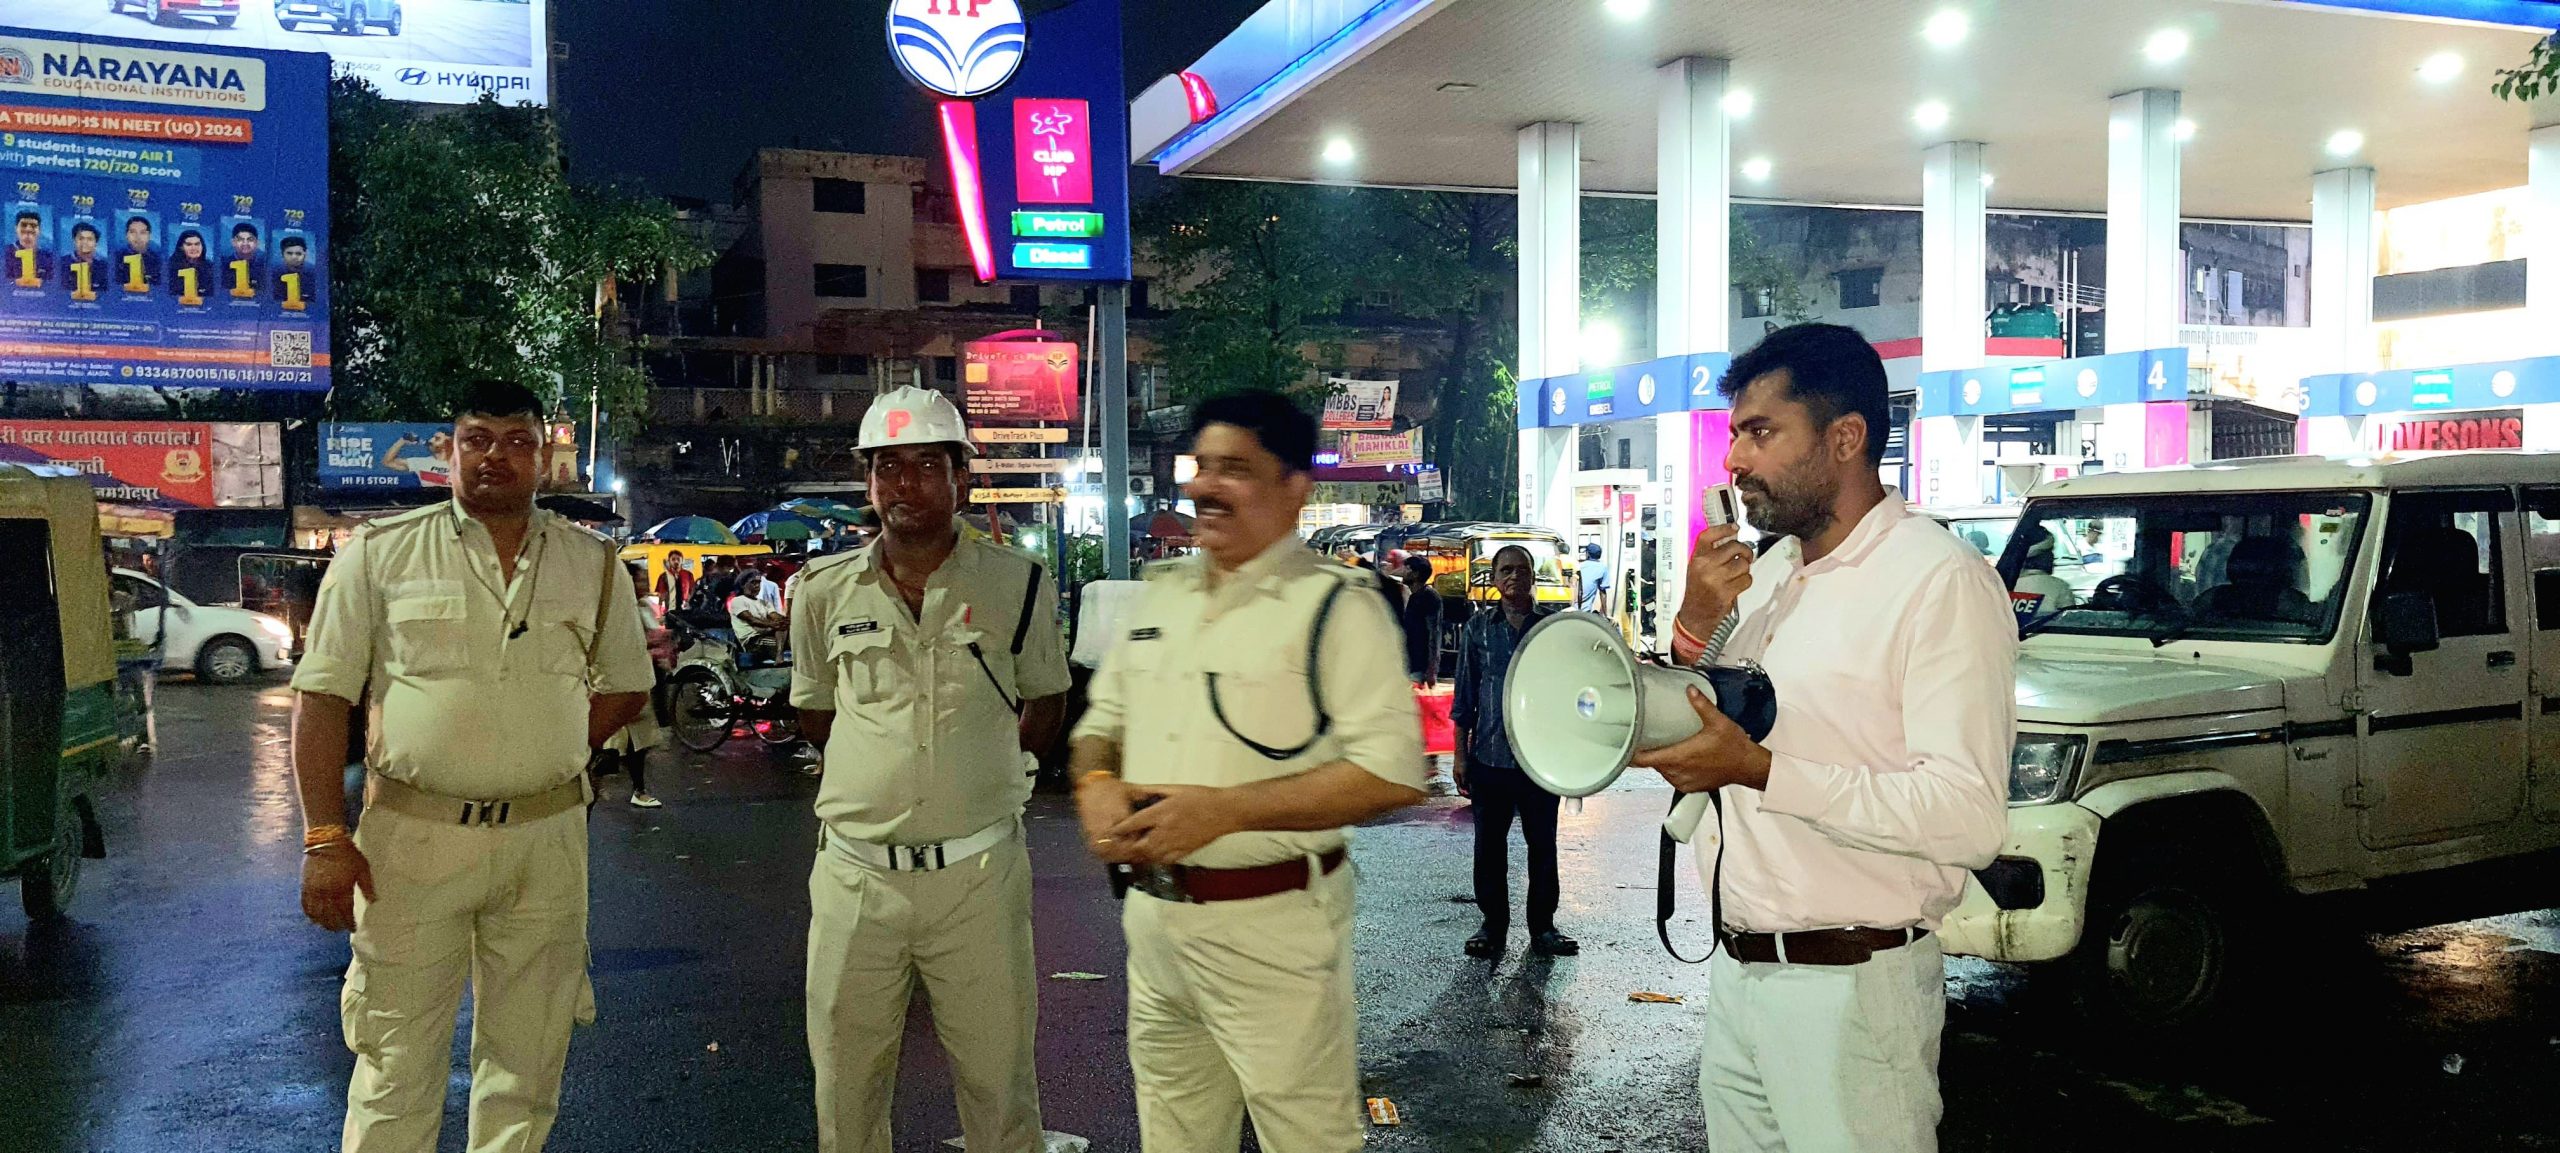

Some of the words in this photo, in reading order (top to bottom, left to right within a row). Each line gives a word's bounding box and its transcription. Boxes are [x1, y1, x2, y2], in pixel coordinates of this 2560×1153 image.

[43, 53, 246, 90] NARAYANA
[437, 72, 530, 91] HYUNDAI
[43, 77, 147, 95] EDUCATIONAL
[151, 87, 247, 104] INSTITUTIONS
[14, 112, 100, 128] TRIUMPHS
[102, 117, 120, 130] IN
[122, 119, 162, 133] NEET
[164, 119, 202, 138] (UG)
[204, 124, 244, 138] 2024
[27, 153, 81, 168] perfect
[84, 158, 140, 174] 720/720
[141, 165, 182, 178] score
[87, 147, 138, 160] secure
[139, 150, 164, 163] AIR
[166, 150, 174, 163] 1
[1032, 216, 1086, 232] Petrol
[15, 248, 43, 288] 1
[70, 261, 97, 301] 1
[124, 253, 149, 292] 1
[229, 259, 256, 298] 1
[178, 267, 204, 306] 1
[280, 272, 307, 312] 1
[1692, 366, 1711, 396] 2
[2147, 360, 2168, 392] 4
[1326, 393, 1357, 411] MBBS
[886, 409, 912, 438] P
[993, 431, 1027, 440] DriveTrack
[1029, 431, 1044, 440] Plus
[341, 476, 353, 485] HI
[355, 476, 365, 485] FI
[367, 476, 399, 485] STORE
